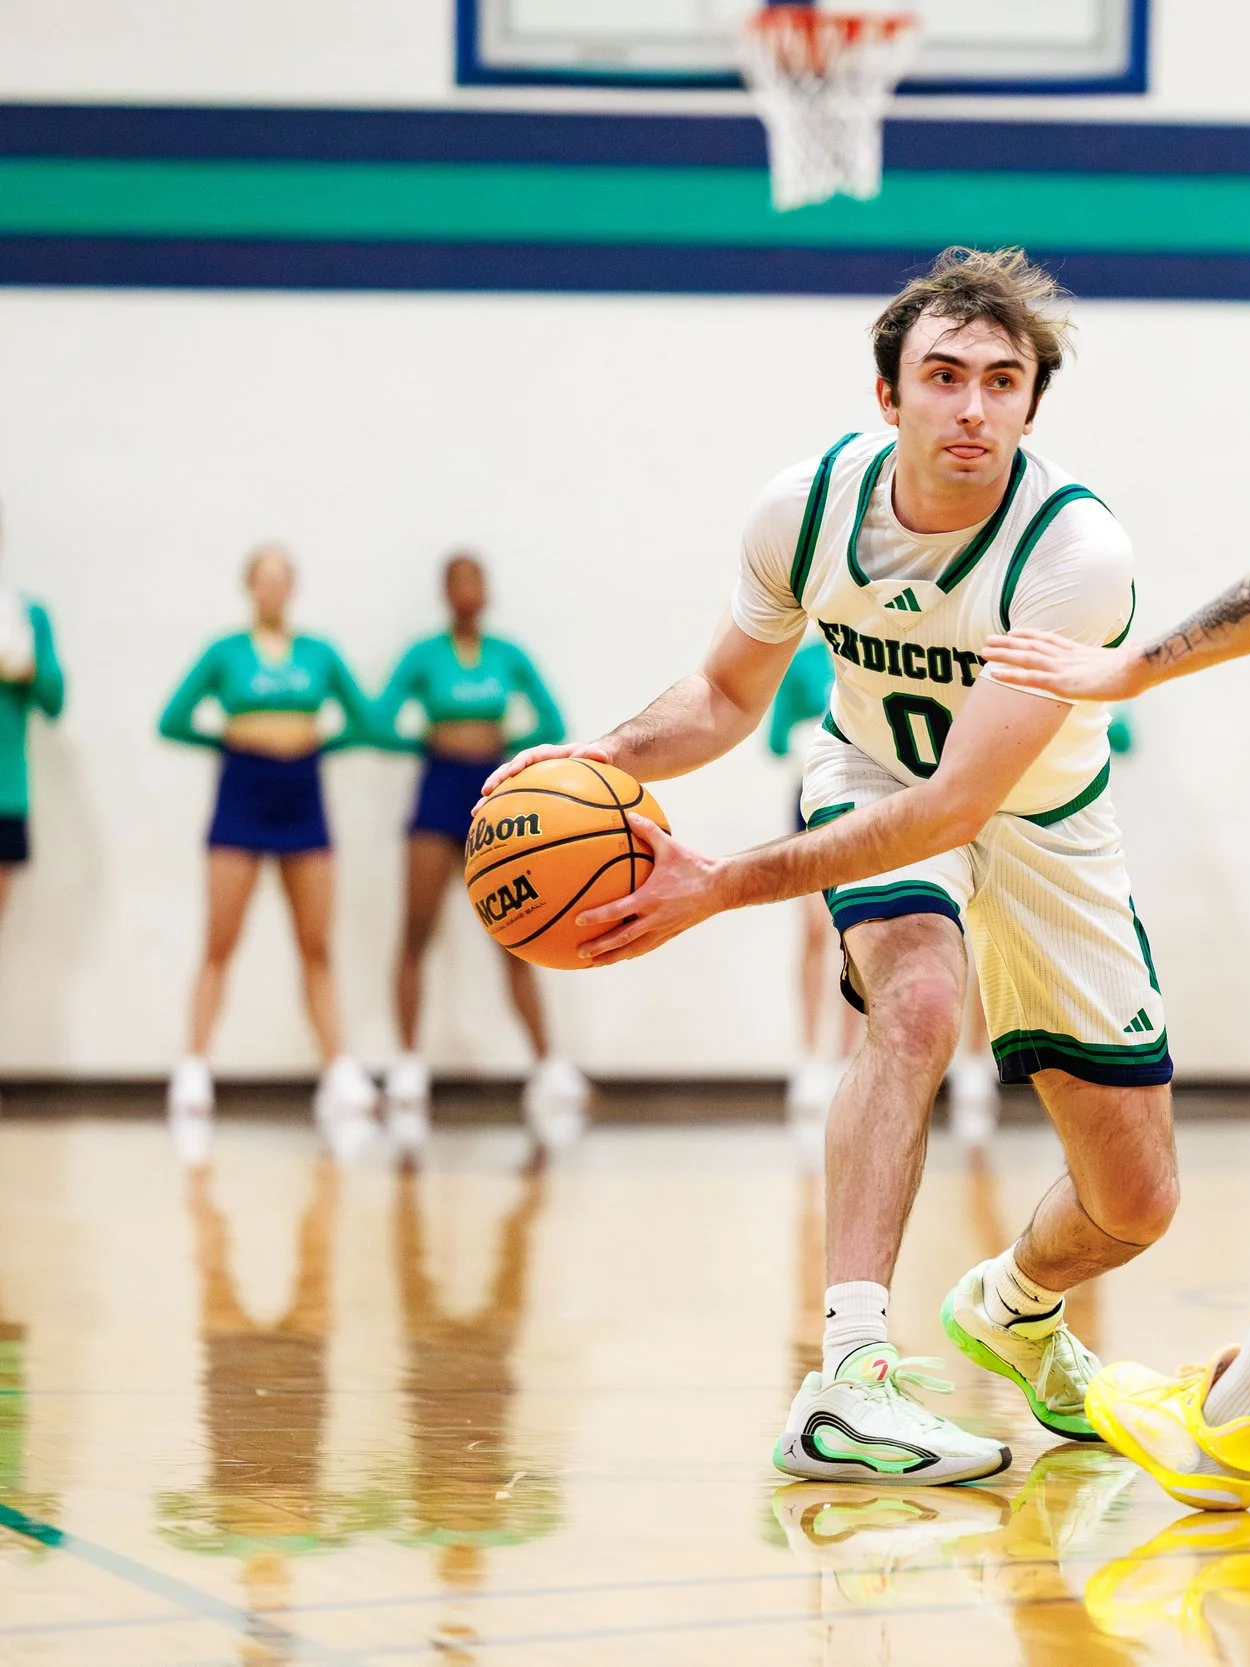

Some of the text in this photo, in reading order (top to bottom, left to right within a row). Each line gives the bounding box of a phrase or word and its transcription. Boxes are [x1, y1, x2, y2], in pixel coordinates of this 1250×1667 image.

[818, 618, 987, 687] ENDICOT
[882, 691, 953, 779] 0
[465, 812, 542, 860] ilson
[474, 873, 540, 928] NCAA
